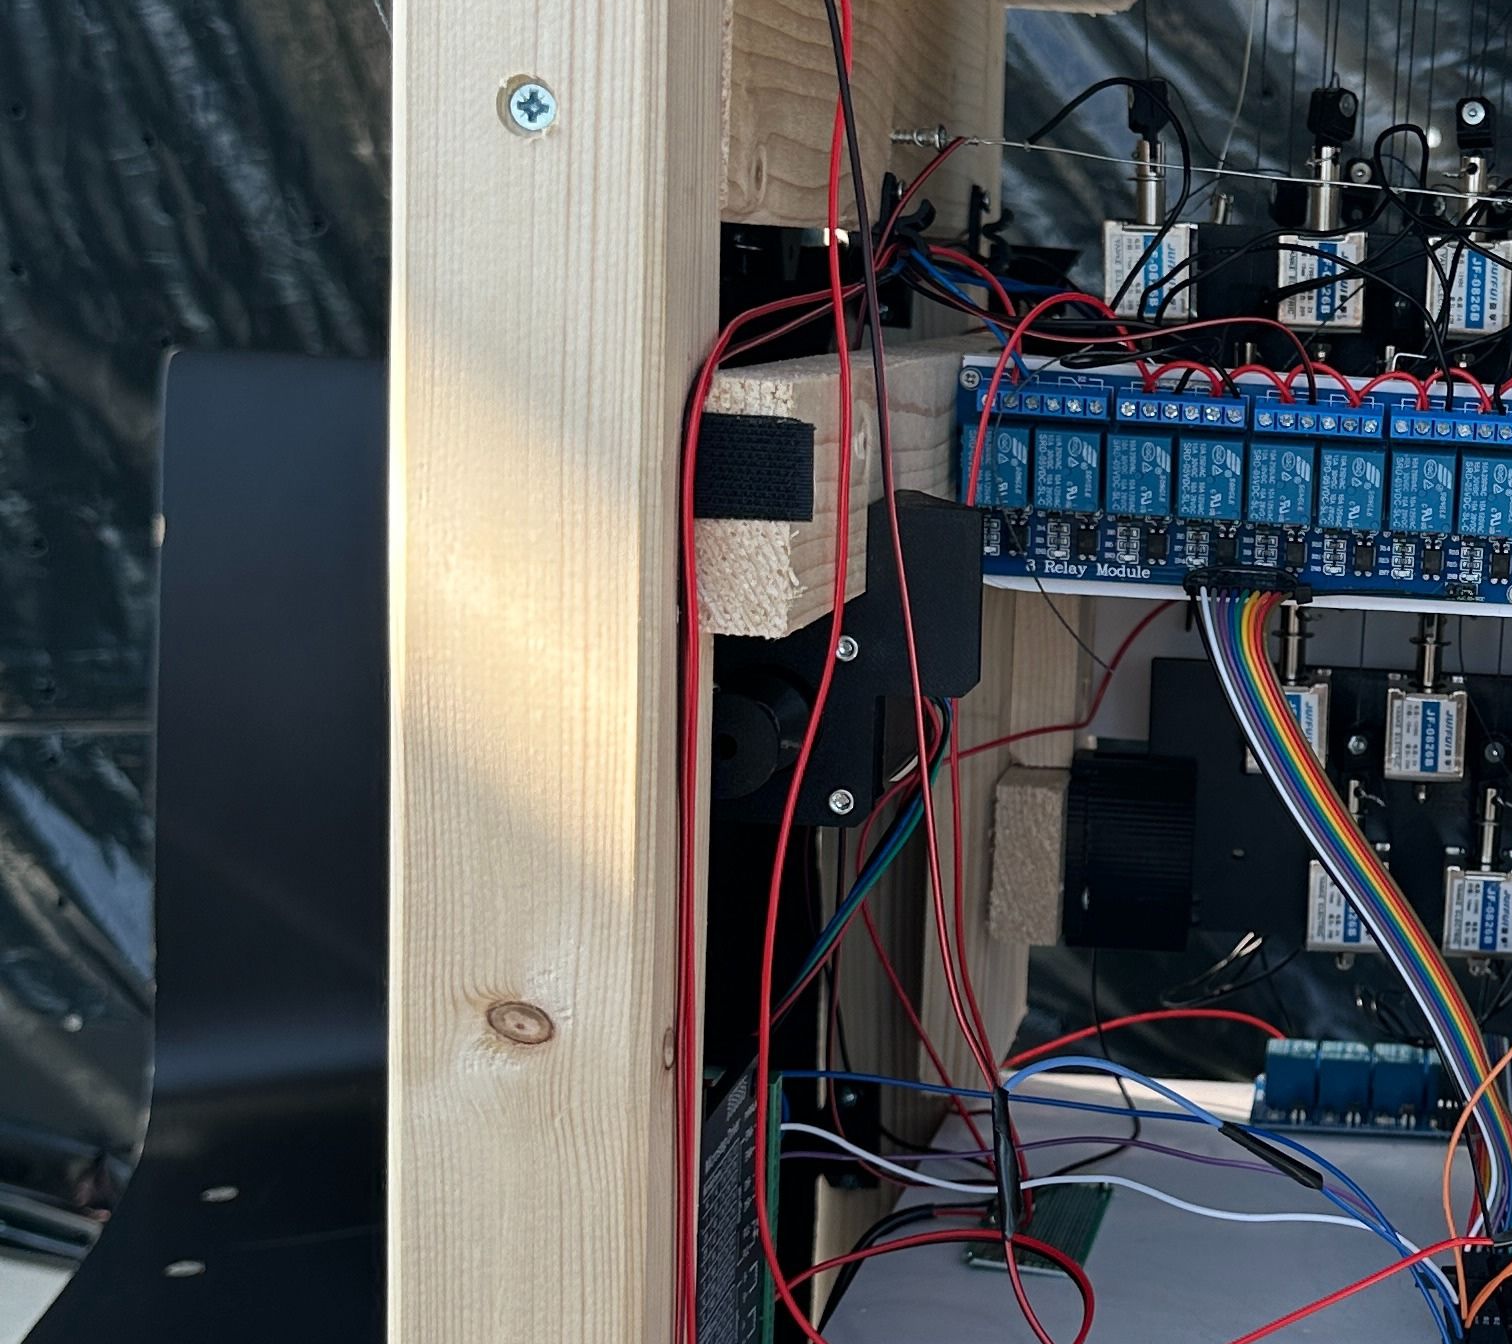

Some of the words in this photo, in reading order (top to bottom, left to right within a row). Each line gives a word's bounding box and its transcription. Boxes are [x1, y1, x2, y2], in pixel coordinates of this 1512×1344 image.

[1469, 257, 1481, 321] JF-0826B
[1044, 559, 1087, 578] Relay
[1096, 562, 1151, 579] Module
[1425, 708, 1435, 767] JF-0826B
[1484, 888, 1494, 944] JF-0826B
